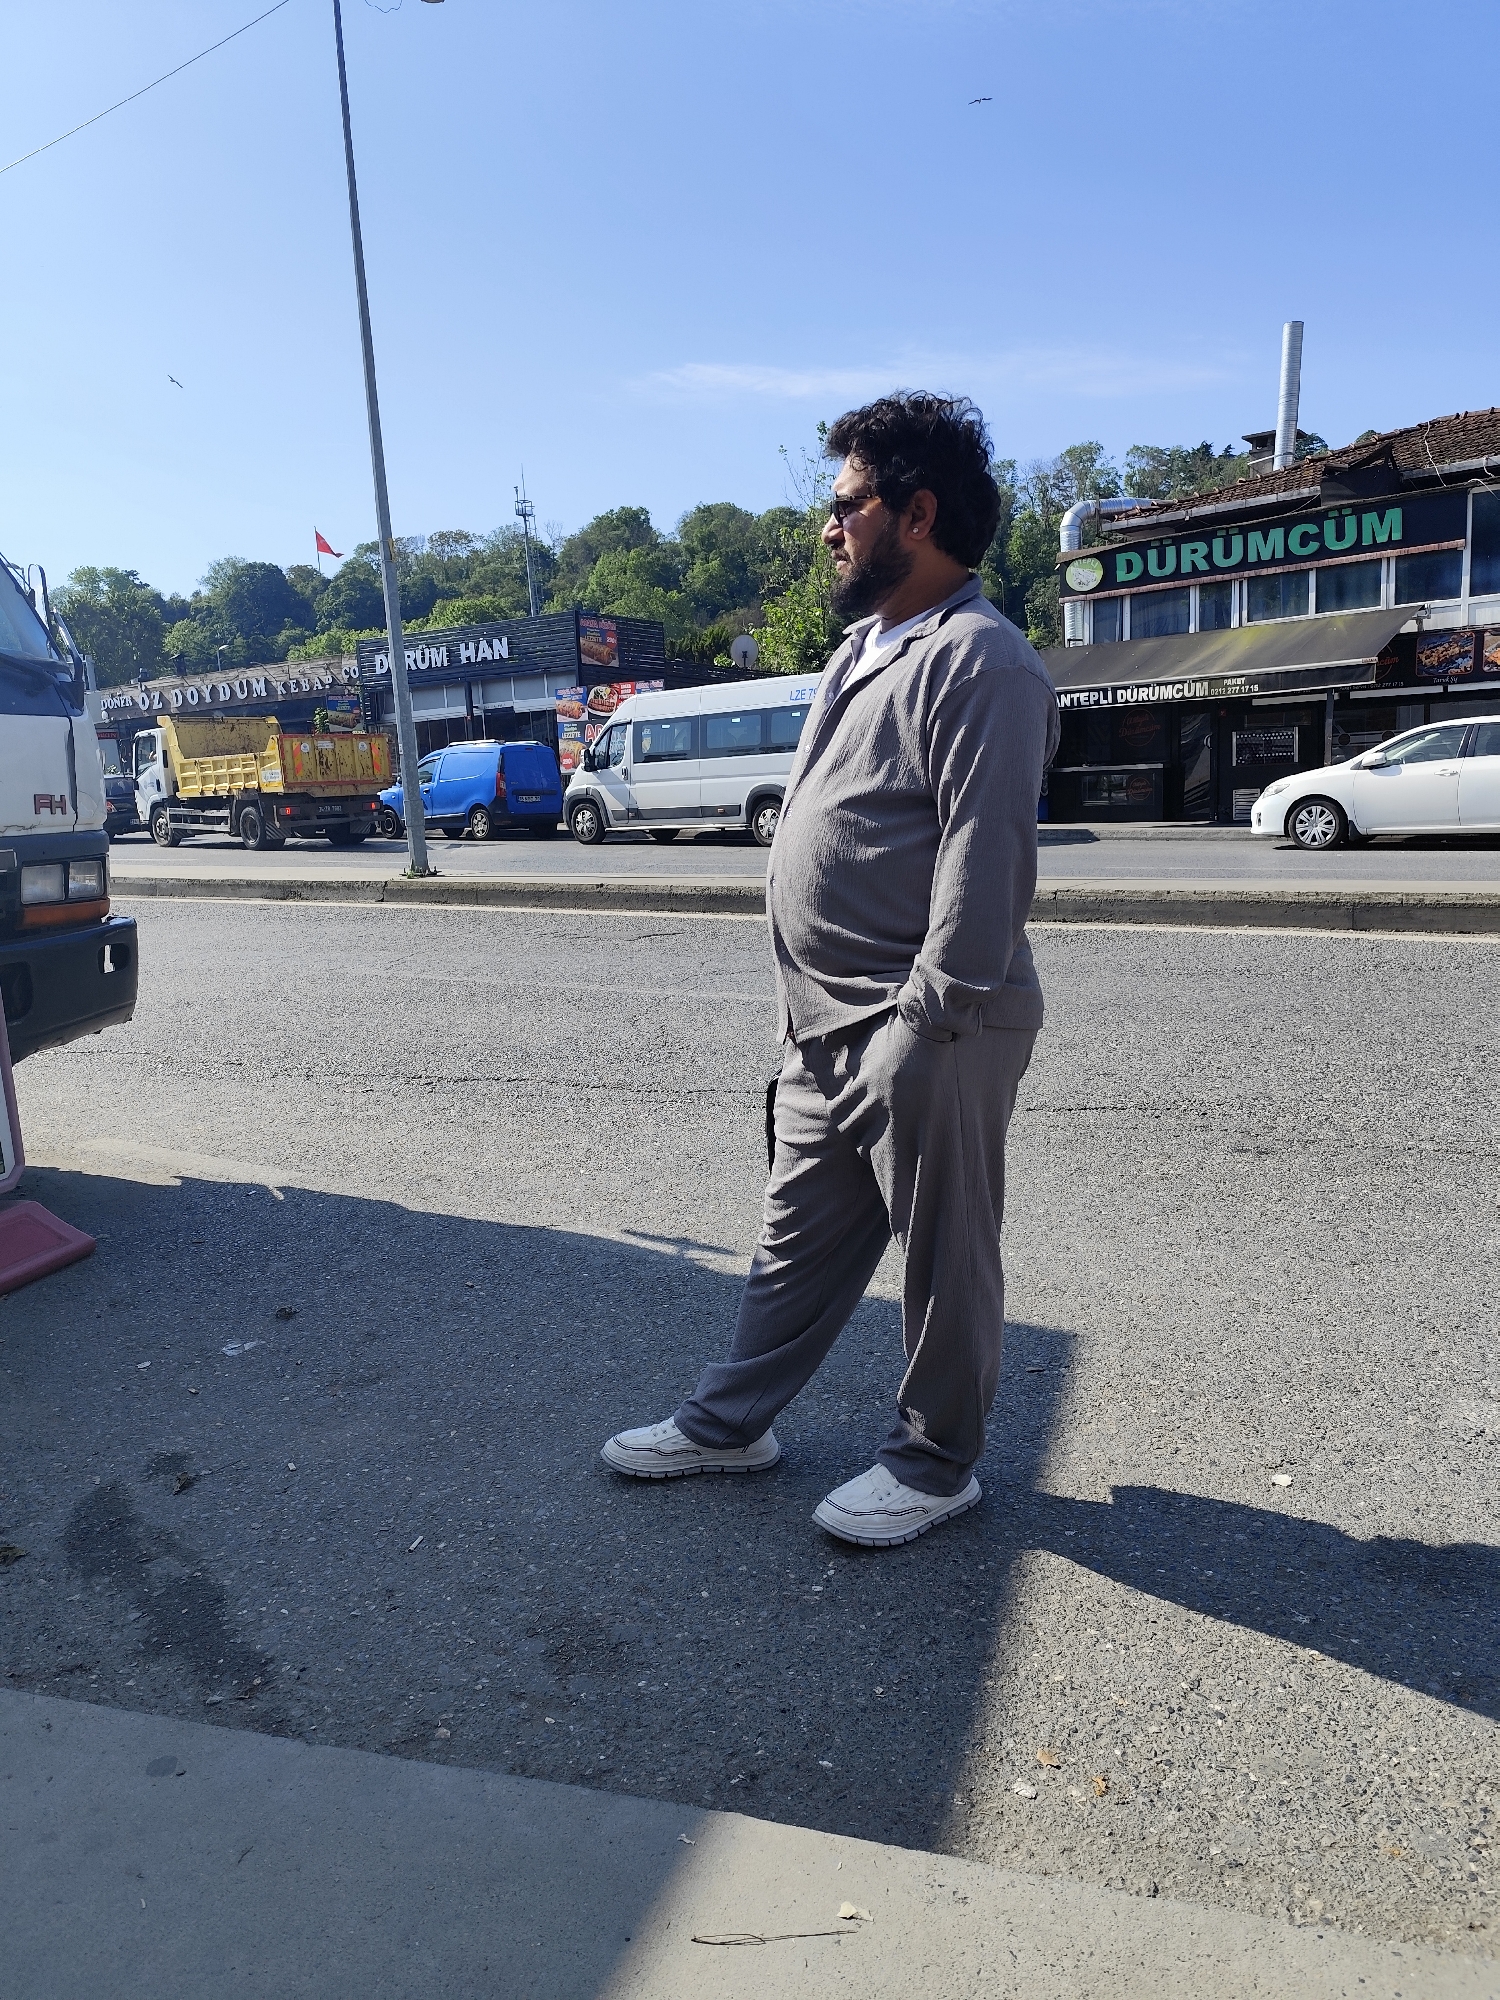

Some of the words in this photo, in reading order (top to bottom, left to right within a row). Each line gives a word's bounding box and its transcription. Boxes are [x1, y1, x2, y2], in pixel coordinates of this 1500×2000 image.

[1116, 508, 1403, 583] DÜRÜMCÜM
[375, 644, 448, 675] DRÜM
[459, 637, 509, 664] HAN
[171, 676, 267, 708] DOYDUM
[277, 675, 333, 695] KEBAP
[1117, 680, 1208, 703] DÜRÜMCÜM
[1210, 687, 1226, 696] 0212
[1227, 686, 1240, 695] 277
[1241, 685, 1250, 694] 17
[1250, 684, 1259, 693] 15
[1223, 677, 1246, 686] PAKET
[790, 689, 806, 701] LZE
[34, 794, 67, 815] FH
